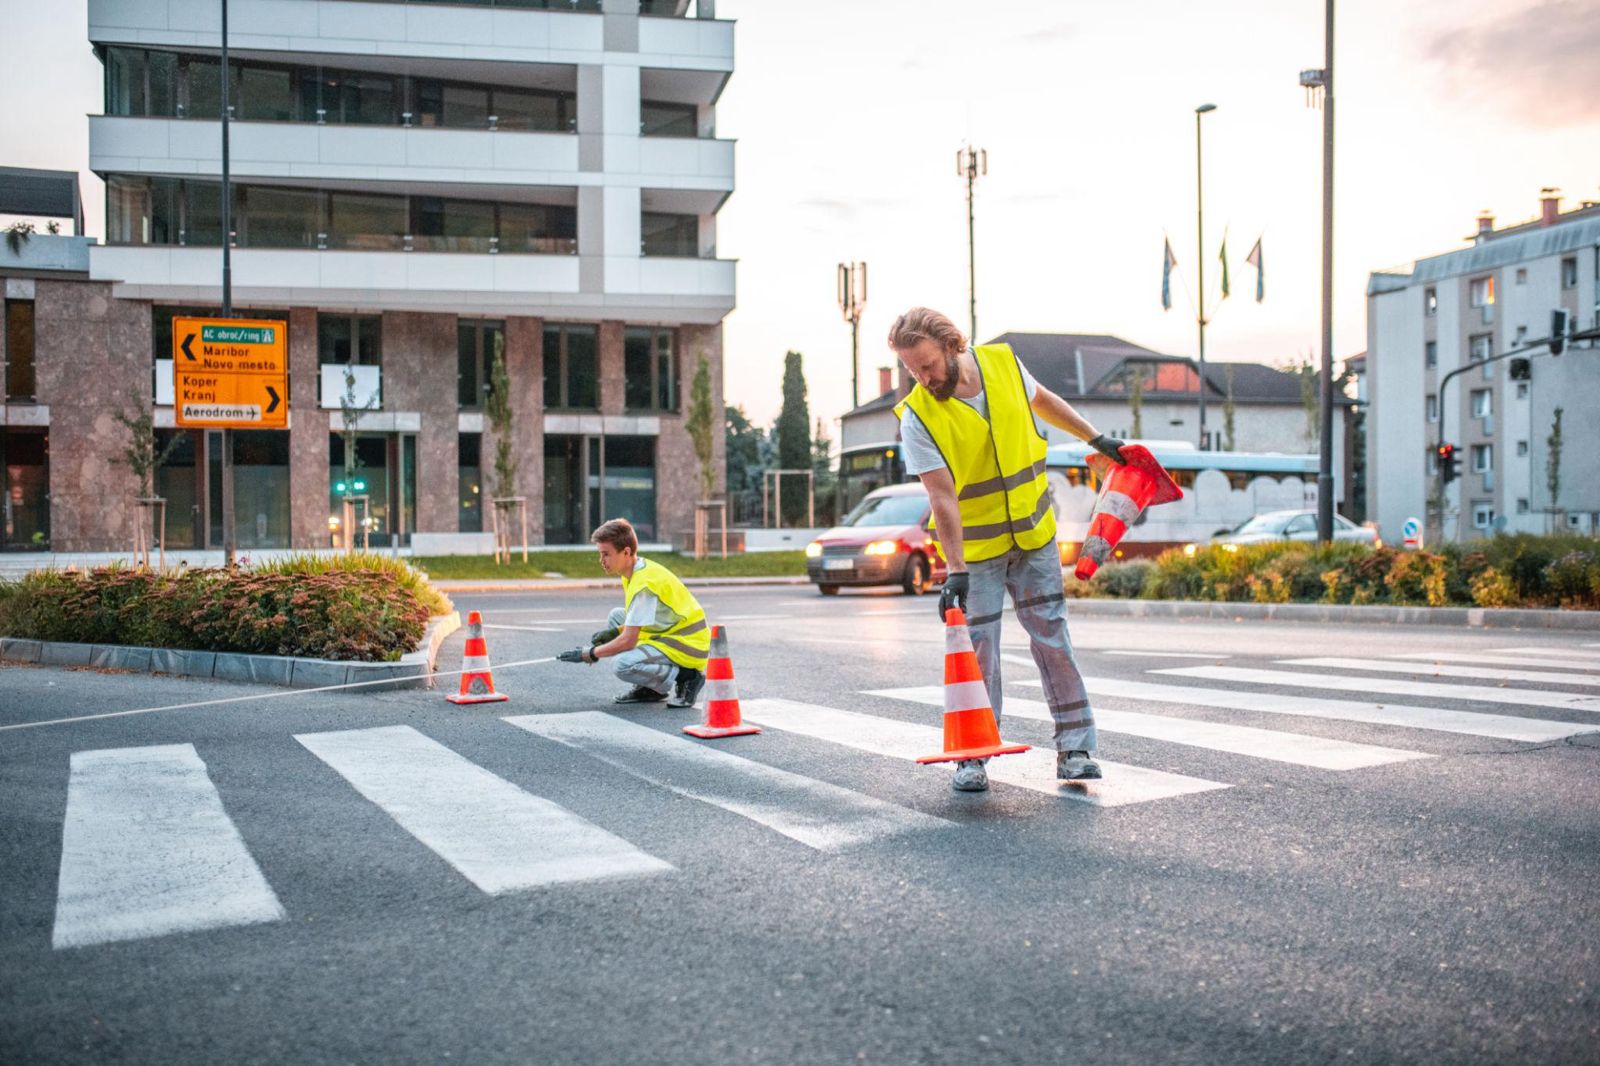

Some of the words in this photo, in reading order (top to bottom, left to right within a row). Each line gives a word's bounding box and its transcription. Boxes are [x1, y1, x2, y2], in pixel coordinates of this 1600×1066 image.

[203, 329, 214, 339] AC
[203, 346, 250, 357] Maribor
[203, 359, 233, 369] Novo
[238, 362, 276, 370] mesto
[183, 376, 218, 388] Koper
[183, 390, 216, 403] Kranj
[184, 407, 244, 418] Aerodrom
